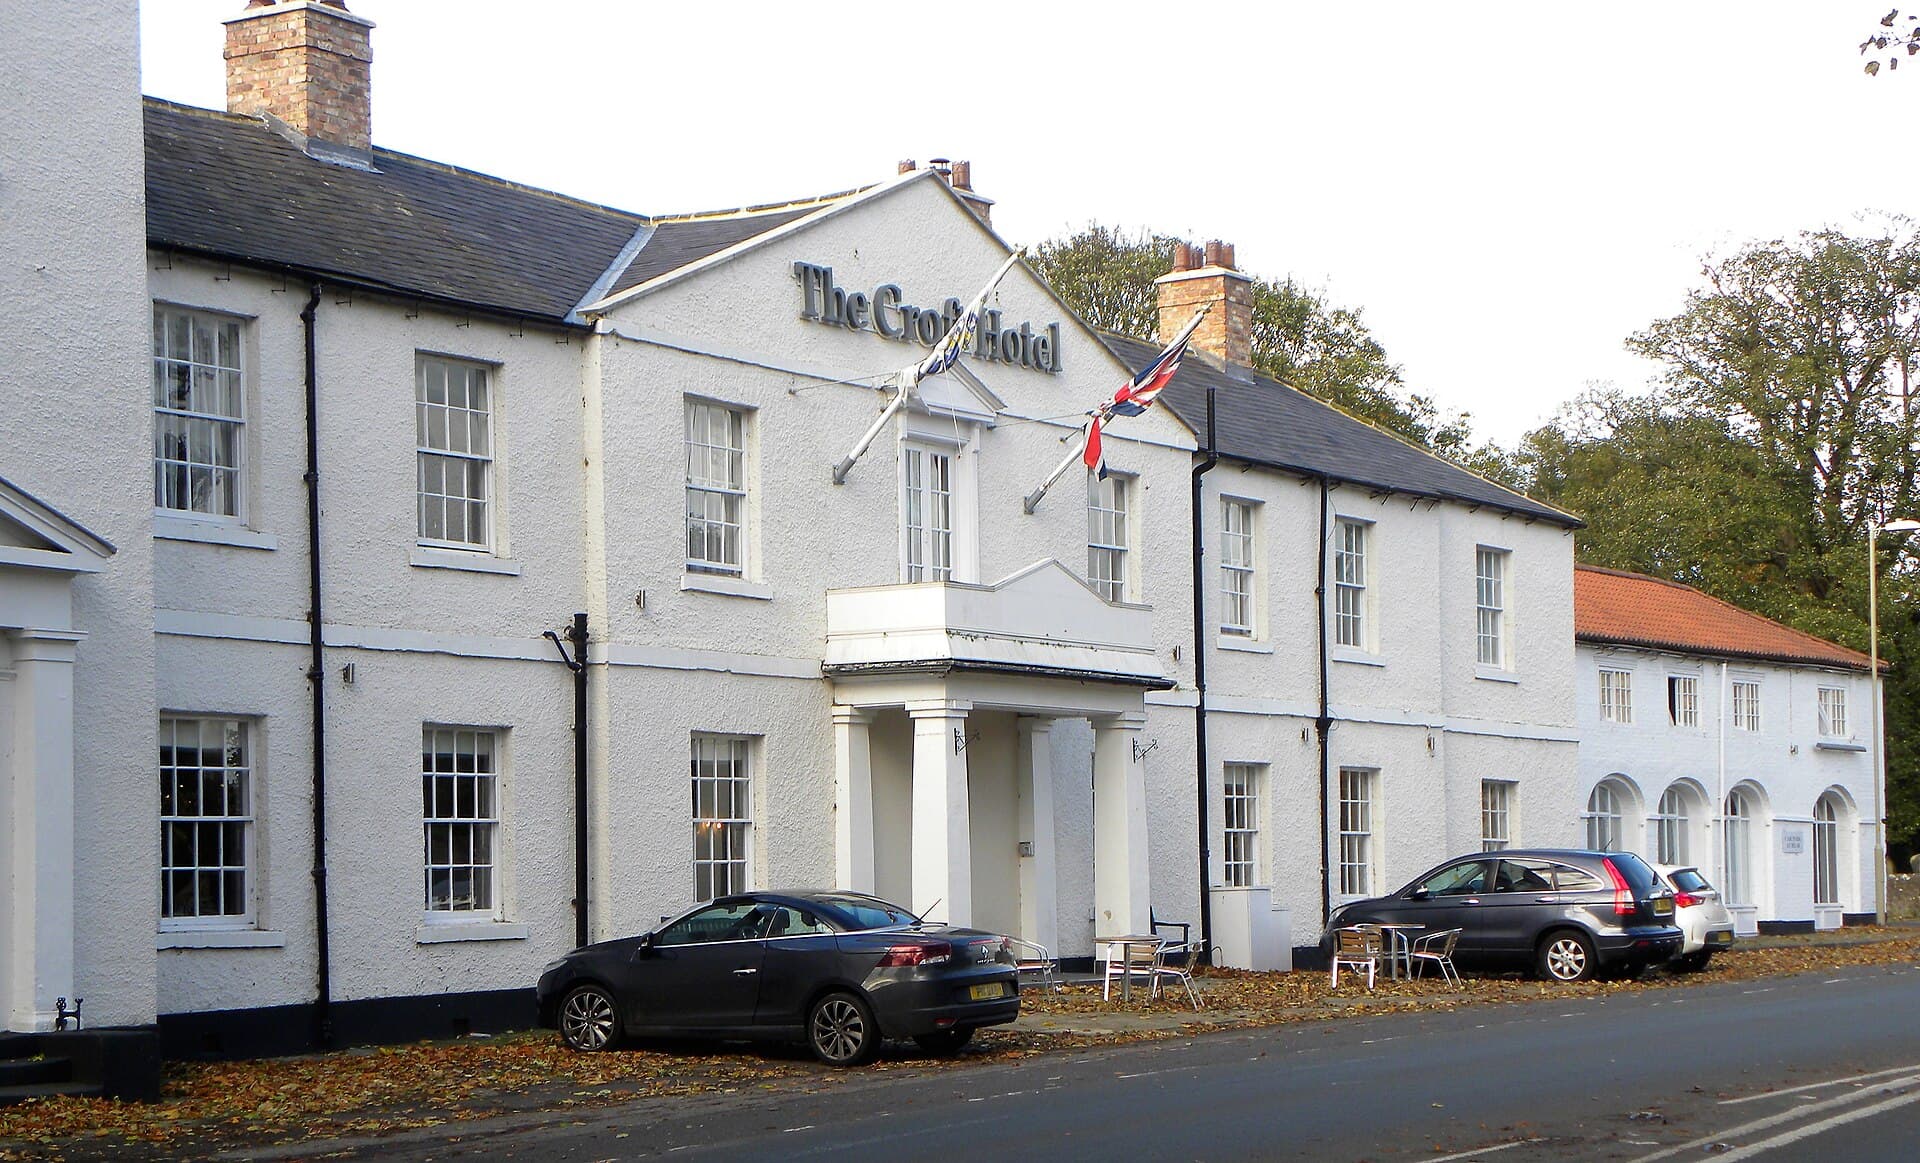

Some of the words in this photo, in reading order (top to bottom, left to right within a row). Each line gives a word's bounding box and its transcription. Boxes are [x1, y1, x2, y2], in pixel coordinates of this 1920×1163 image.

[793, 261, 869, 329] The
[872, 283, 963, 348] Crof
[974, 305, 1062, 374] Hotel
